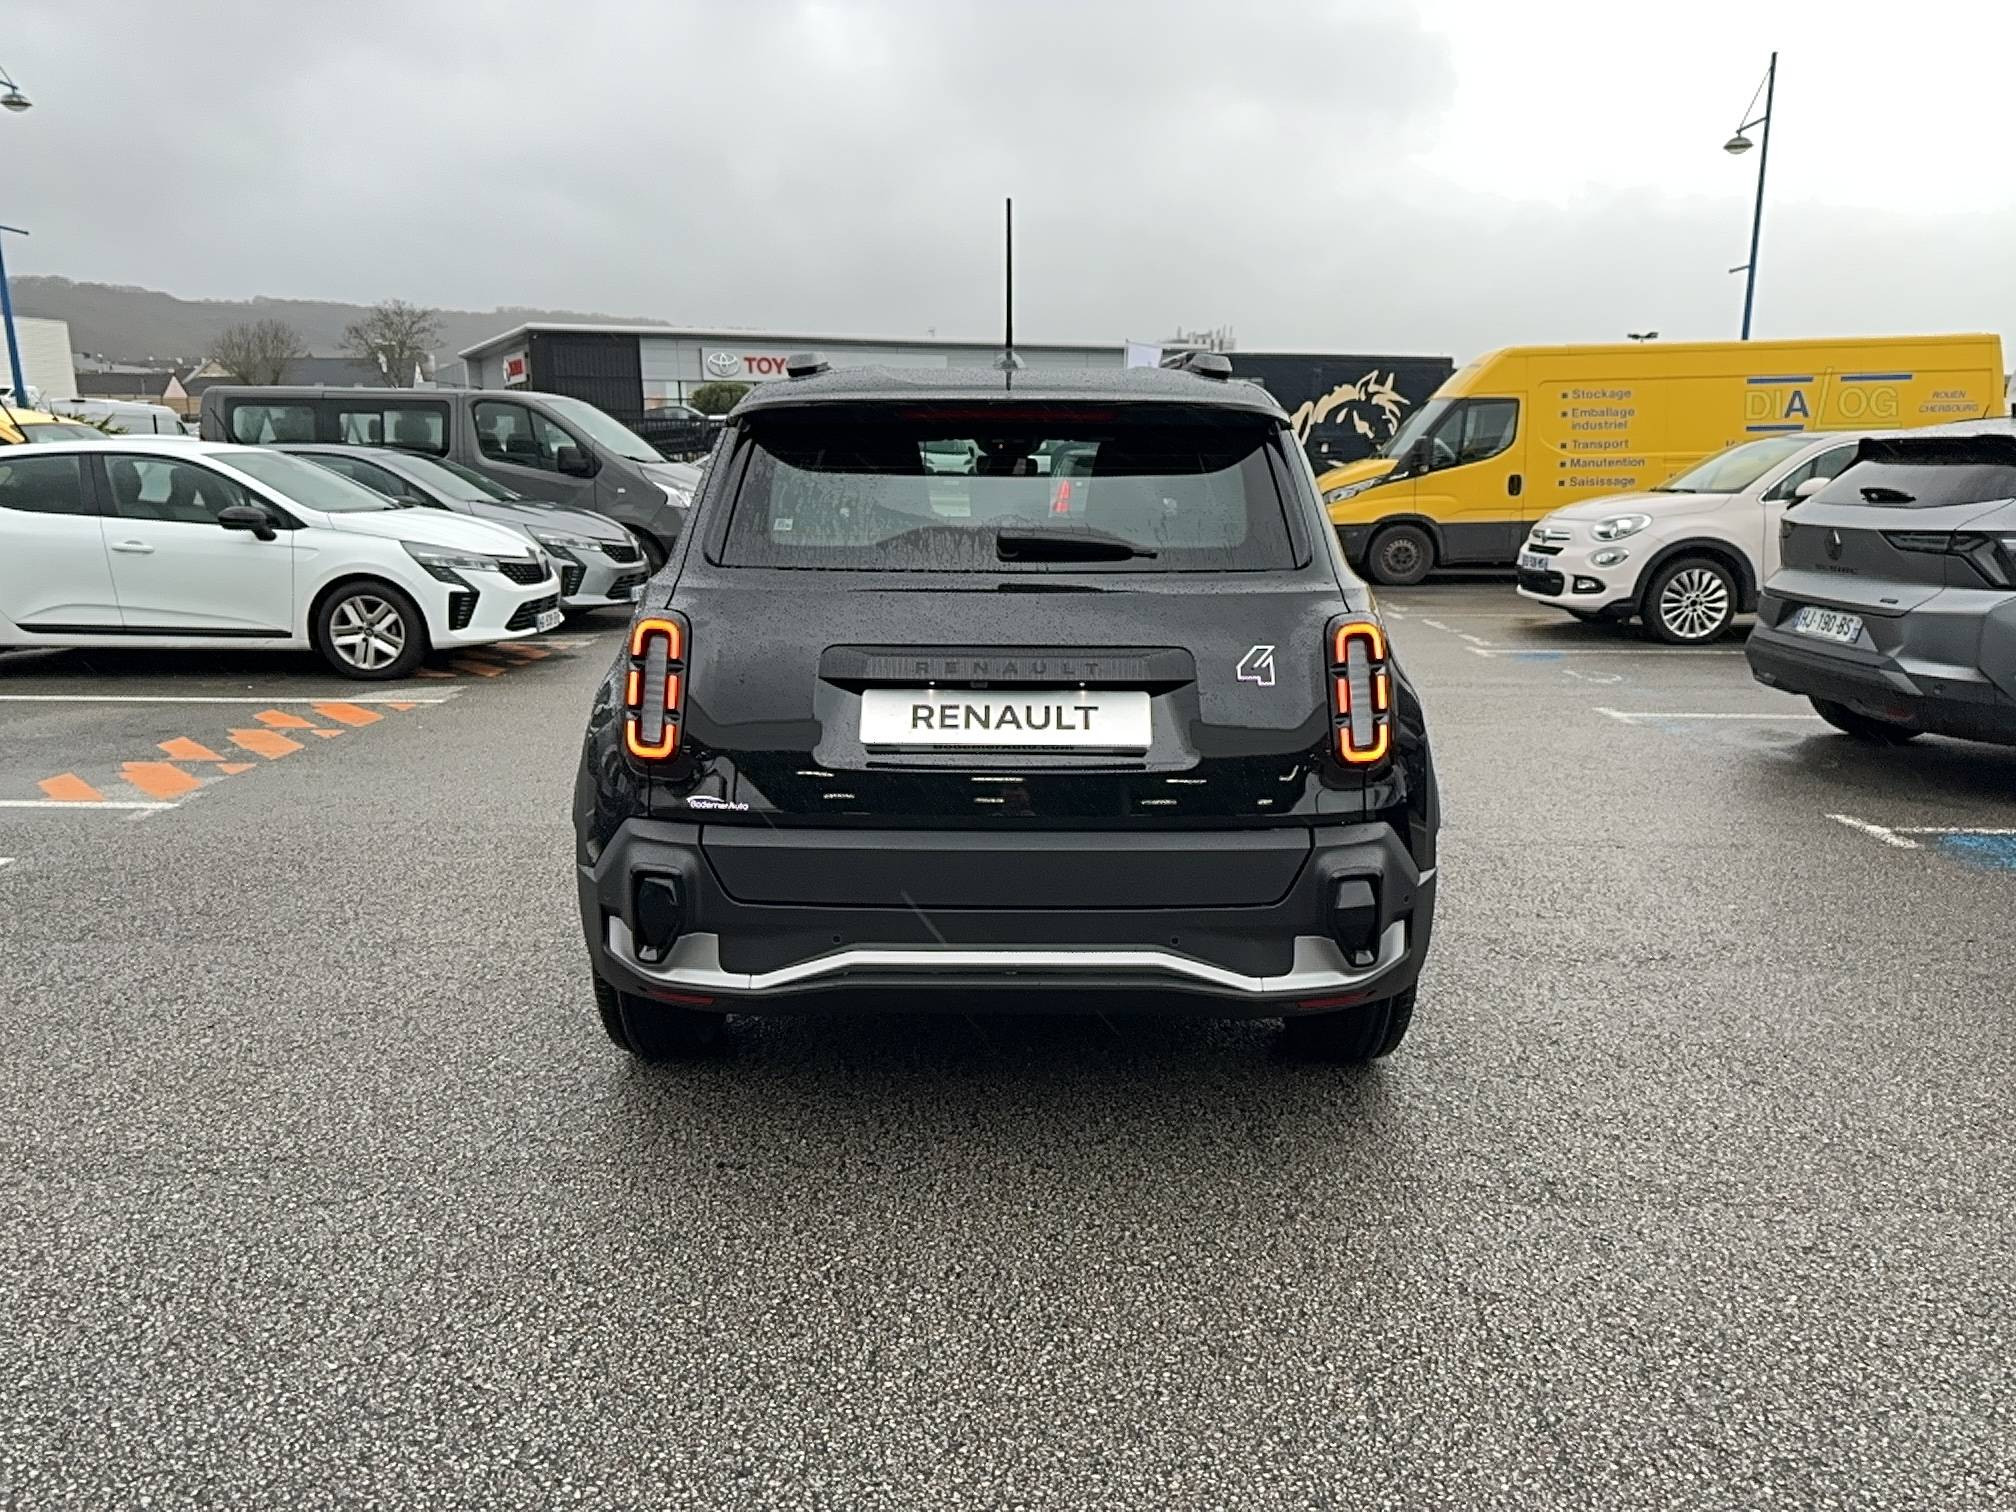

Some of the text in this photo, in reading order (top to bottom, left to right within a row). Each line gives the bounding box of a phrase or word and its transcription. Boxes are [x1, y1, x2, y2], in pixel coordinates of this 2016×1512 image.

[744, 357, 792, 374] TOY
[1572, 389, 1632, 400] Stockage
[1744, 367, 1903, 430] DIALOG
[1932, 390, 1967, 399] ROUEN
[1571, 407, 1635, 418] Emballage
[1919, 402, 1979, 413] CHERBOURG
[1571, 420, 1628, 430] industriel
[1573, 439, 1630, 450] Transport
[1570, 458, 1645, 468] Manutention
[1569, 476, 1636, 488] Saisissage
[914, 661, 1100, 675] RENAULT
[911, 704, 1099, 731] RENAULT
